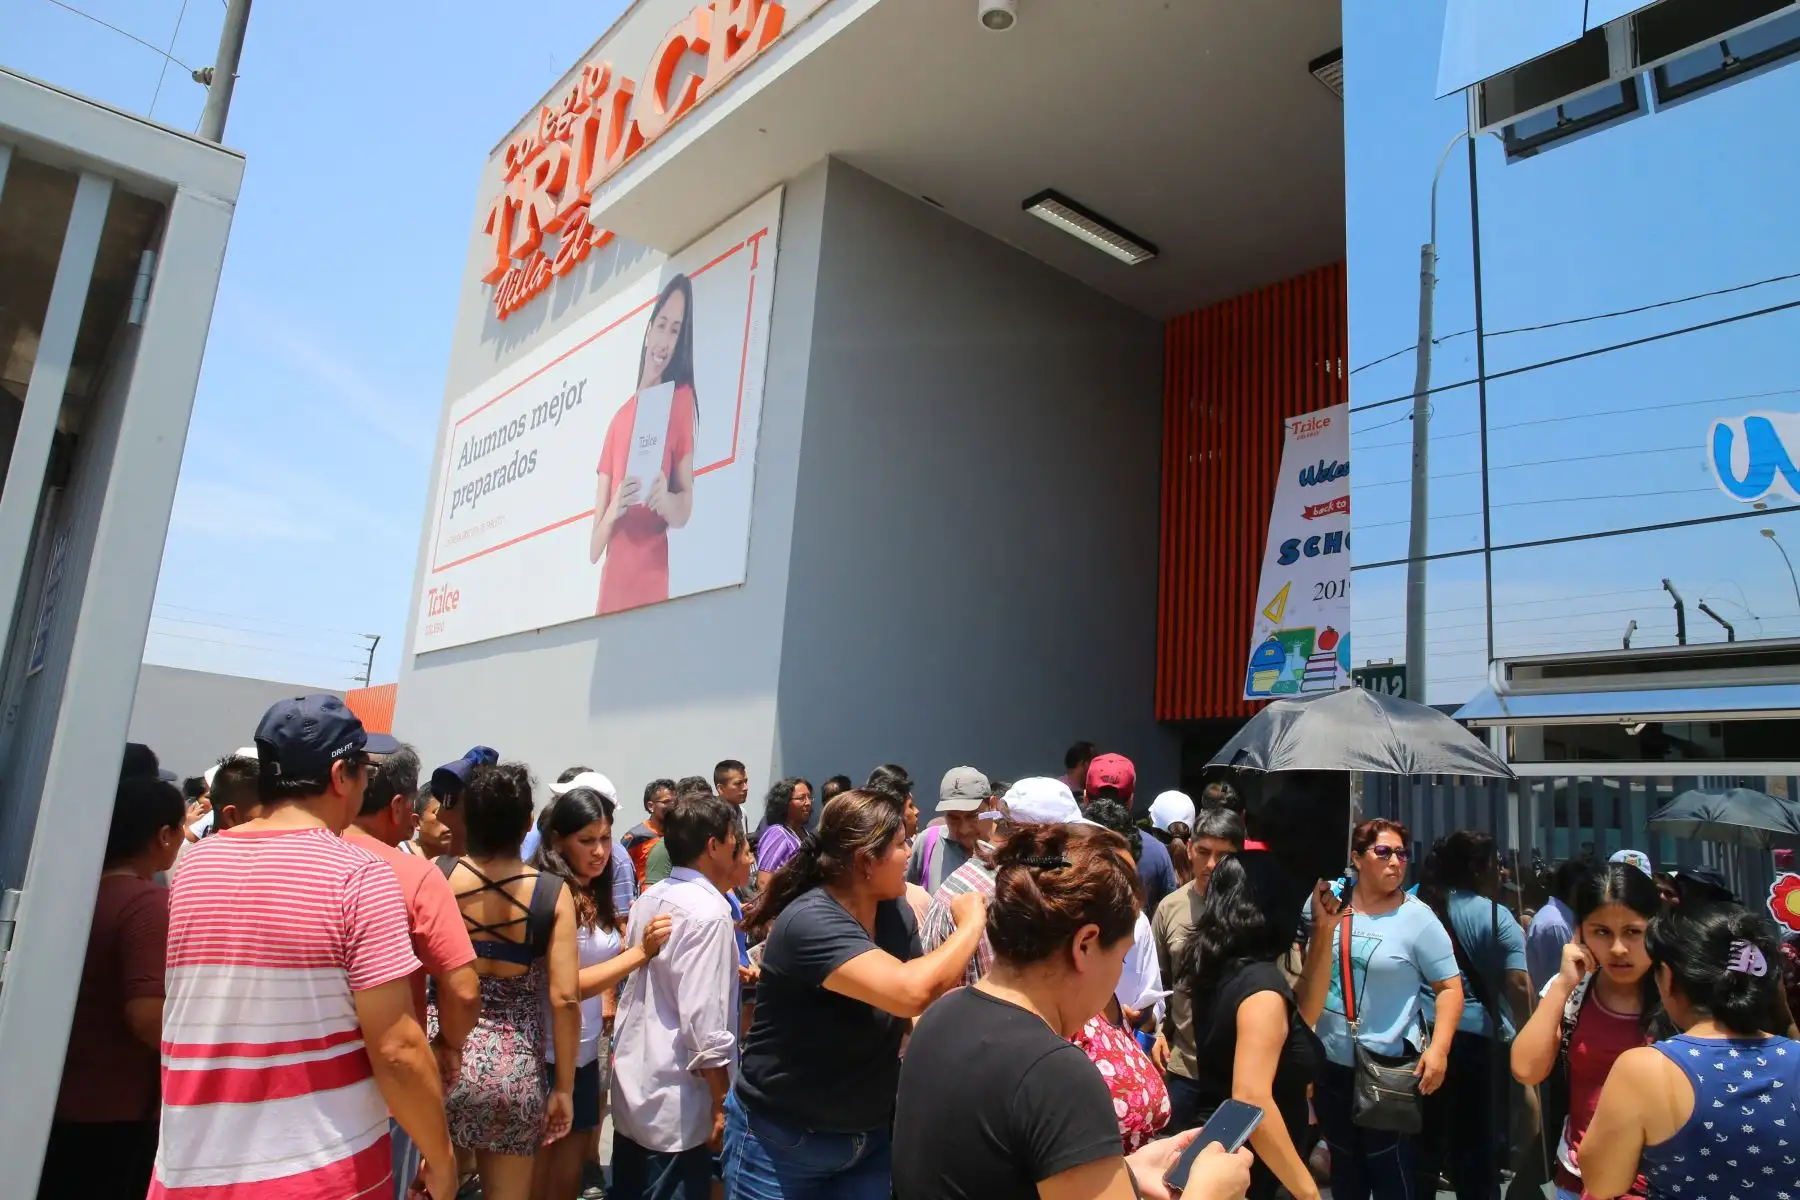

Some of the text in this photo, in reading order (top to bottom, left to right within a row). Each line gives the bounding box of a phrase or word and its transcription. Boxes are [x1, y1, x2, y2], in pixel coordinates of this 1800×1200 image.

[494, 206, 594, 320] Villa El
[457, 377, 588, 470] Alumnos mejor
[1291, 416, 1331, 435] Trilce
[449, 448, 538, 520] preparados
[1313, 500, 1347, 516] back to
[1277, 531, 1350, 566] SCH
[427, 582, 460, 617] Trilce
[1312, 579, 1350, 601] 201
[331, 742, 353, 758] DRI-FIT
